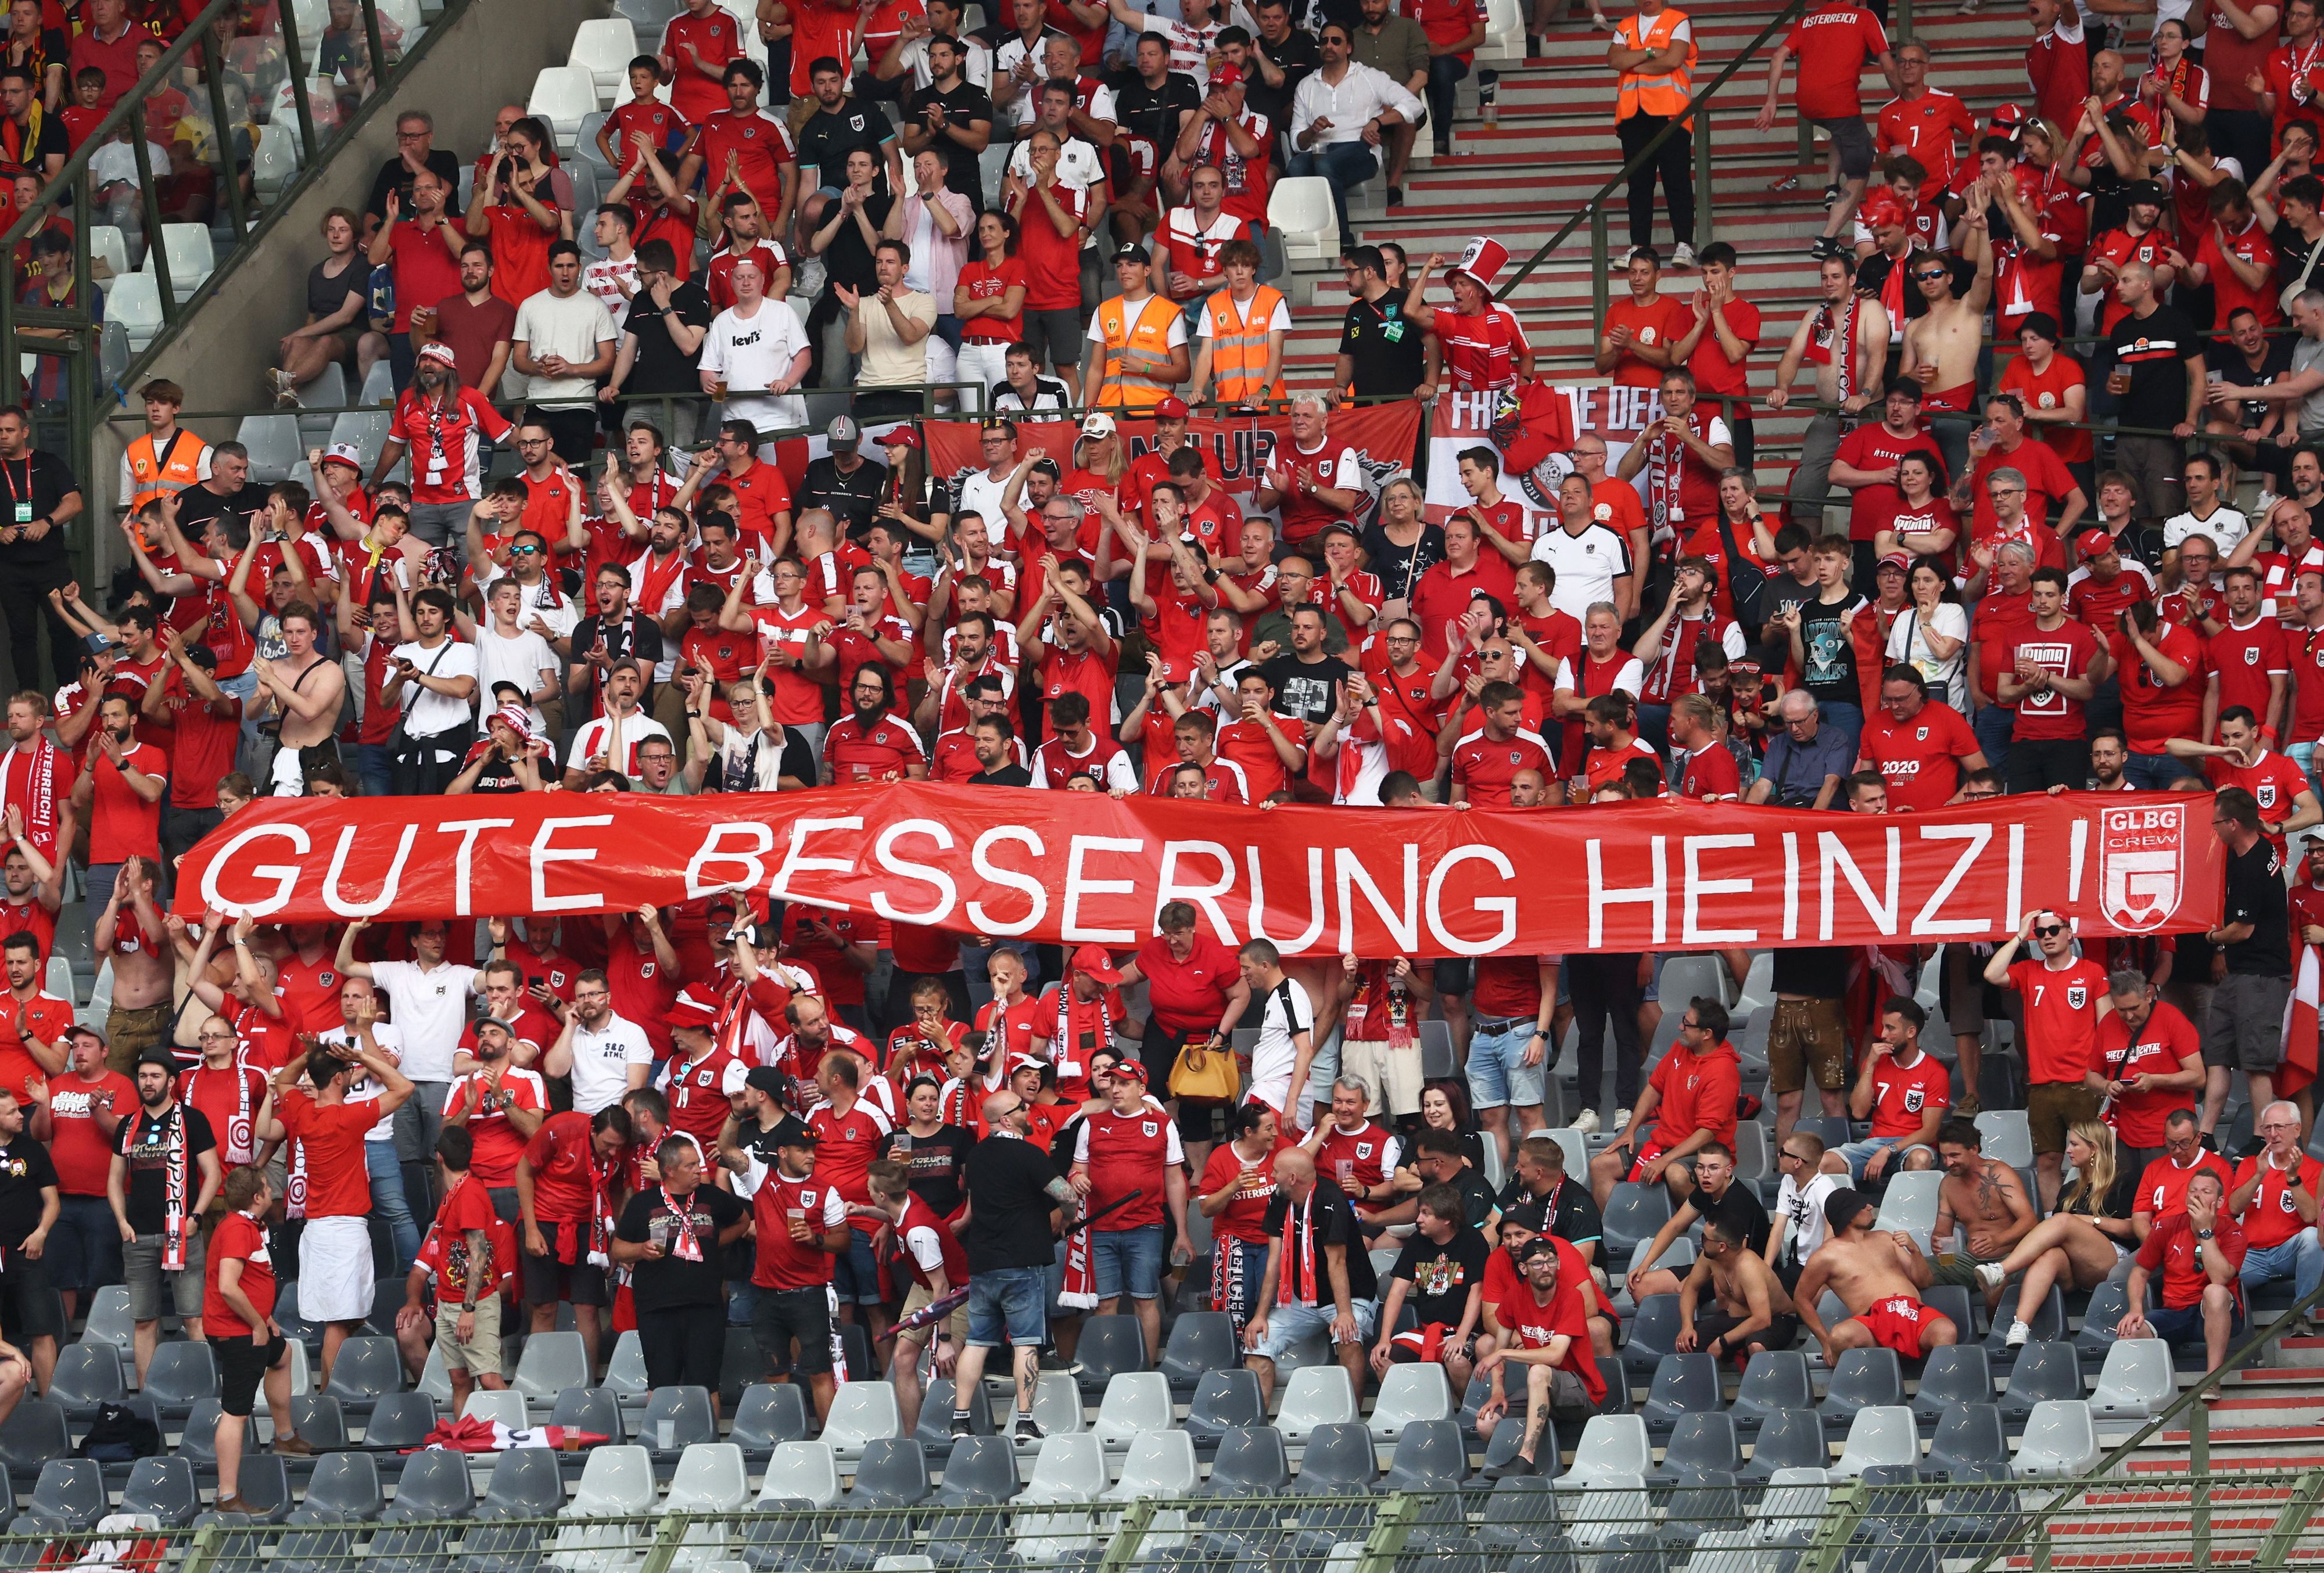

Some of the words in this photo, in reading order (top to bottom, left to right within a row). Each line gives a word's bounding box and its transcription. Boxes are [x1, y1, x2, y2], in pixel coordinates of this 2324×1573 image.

[1802, 13, 1858, 29] ÖSTERREICH
[1910, 125, 1919, 148] 7
[1896, 519, 1931, 531] PUMA
[2024, 648, 2065, 663] PUMA
[1881, 760, 1920, 775] 2020
[478, 777, 498, 788] JUST
[2110, 811, 2178, 831] GLBG
[2109, 834, 2178, 847] CREW
[200, 814, 614, 918] GUTE
[684, 816, 1517, 955] BESSERUNG
[2034, 985, 2045, 1007] 7
[605, 1043, 625, 1052] S&D
[1877, 1082, 1891, 1107] 7
[2153, 1186, 2165, 1211] 4
